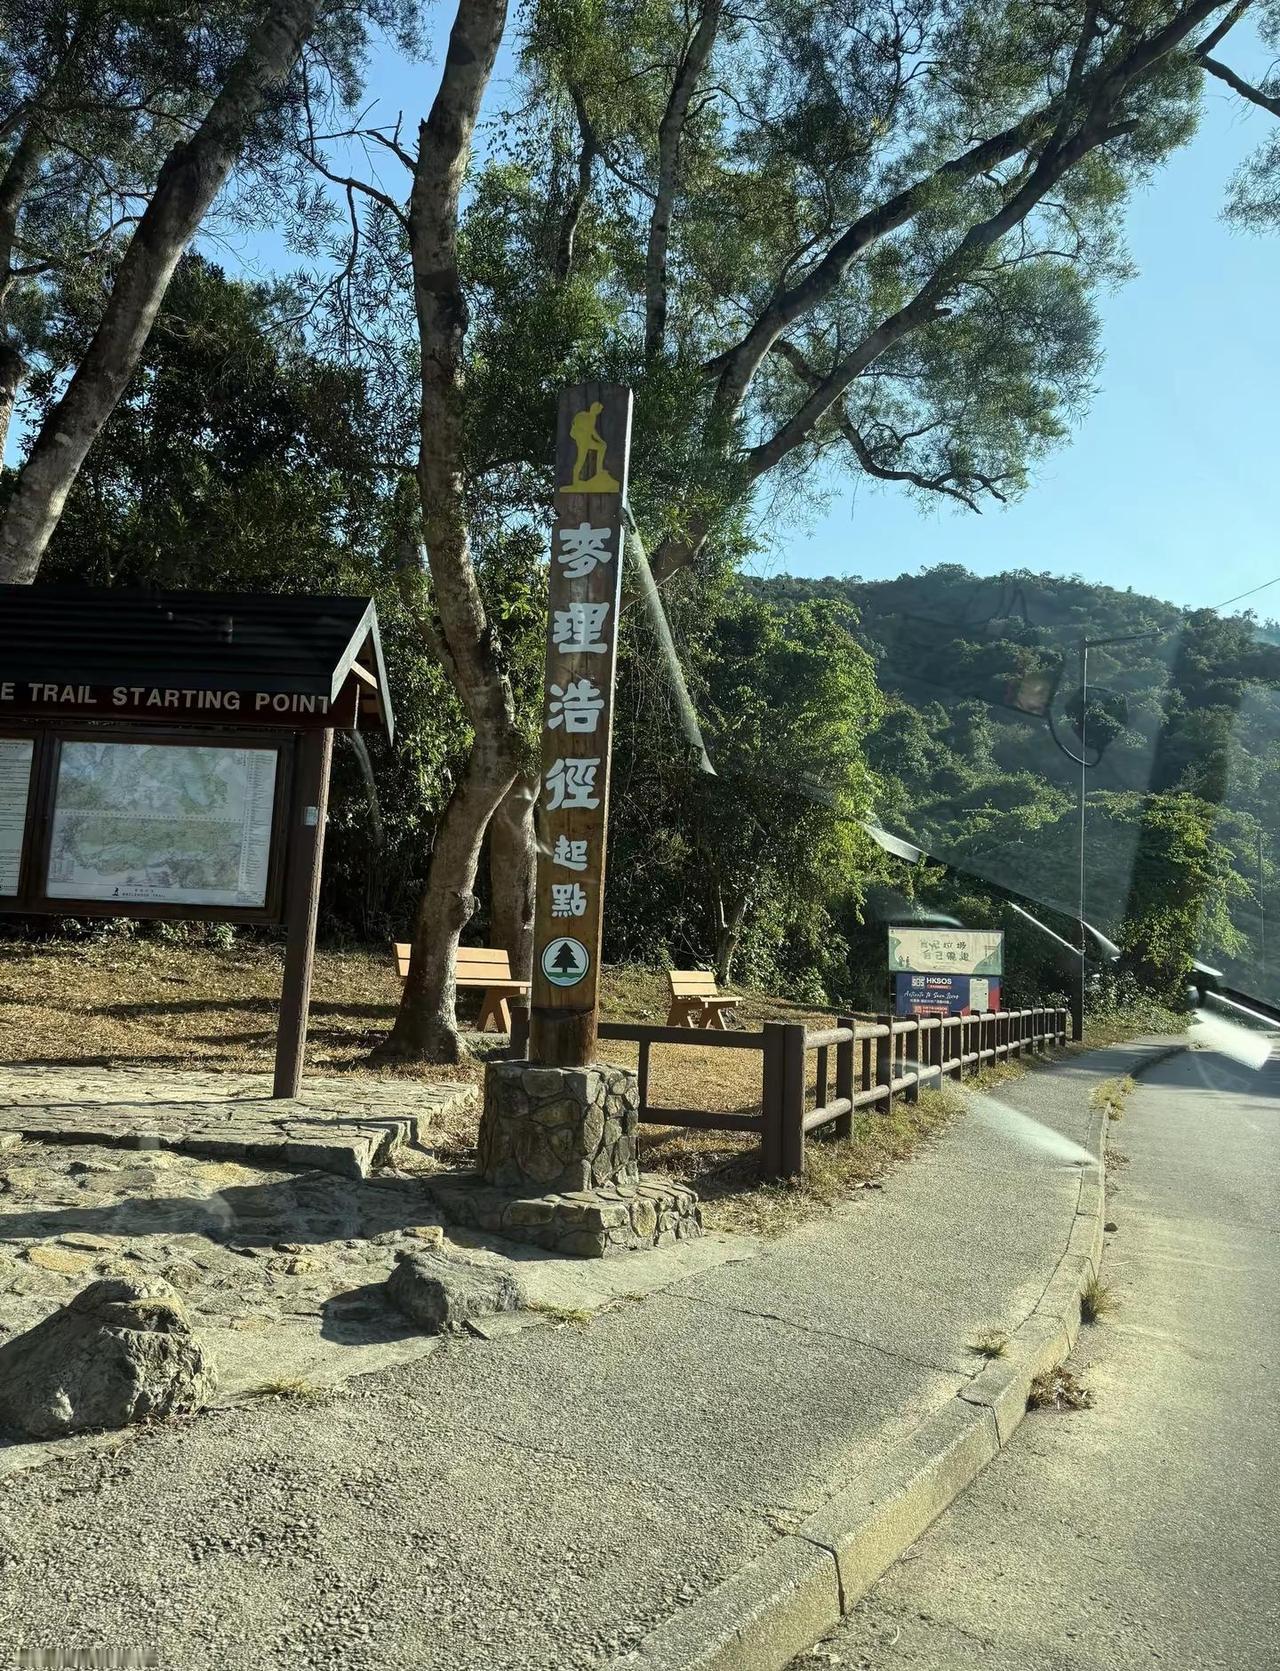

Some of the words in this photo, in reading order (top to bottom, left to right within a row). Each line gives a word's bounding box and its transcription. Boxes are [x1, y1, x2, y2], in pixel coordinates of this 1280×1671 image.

[28, 682, 97, 704] TRAIL
[112, 686, 240, 711] STARTING
[255, 692, 329, 715] POINT
[545, 521, 612, 917] 麥理浩徑起點
[926, 977, 952, 985] HKSOS
